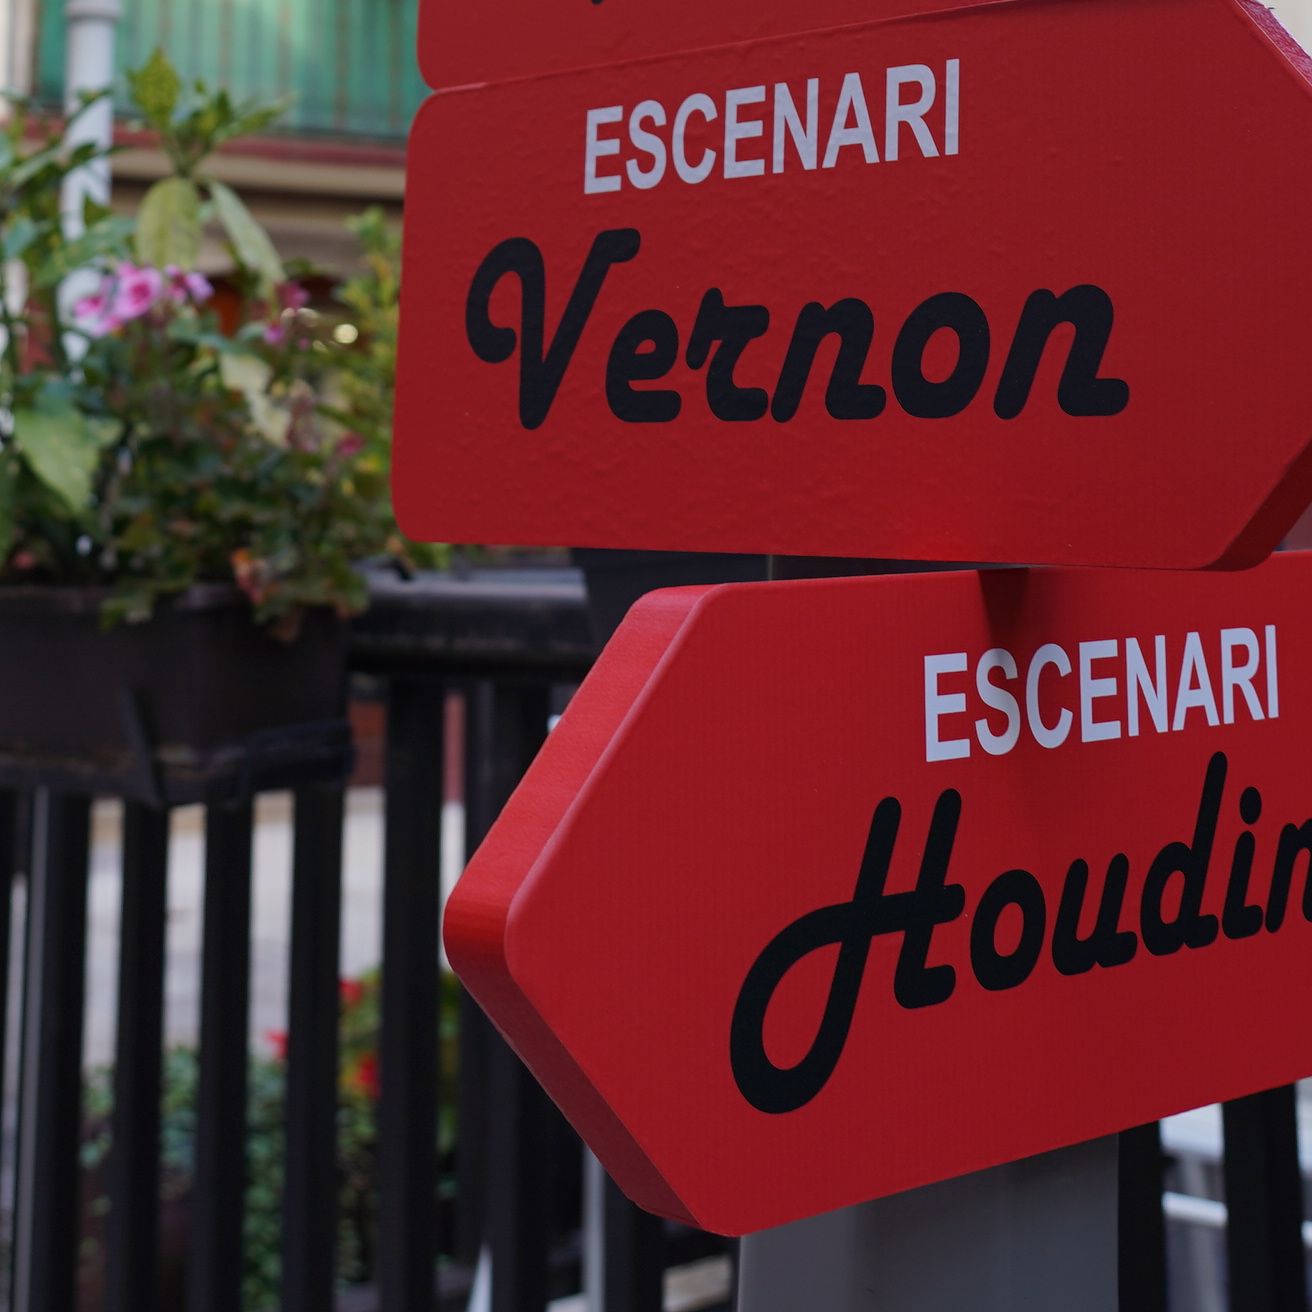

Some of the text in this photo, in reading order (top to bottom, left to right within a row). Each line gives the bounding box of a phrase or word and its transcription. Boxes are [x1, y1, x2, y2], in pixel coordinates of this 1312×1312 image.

[583, 58, 961, 195] ESCENARI
[464, 227, 1130, 431] Vernon
[923, 624, 1281, 763] ESCENARI
